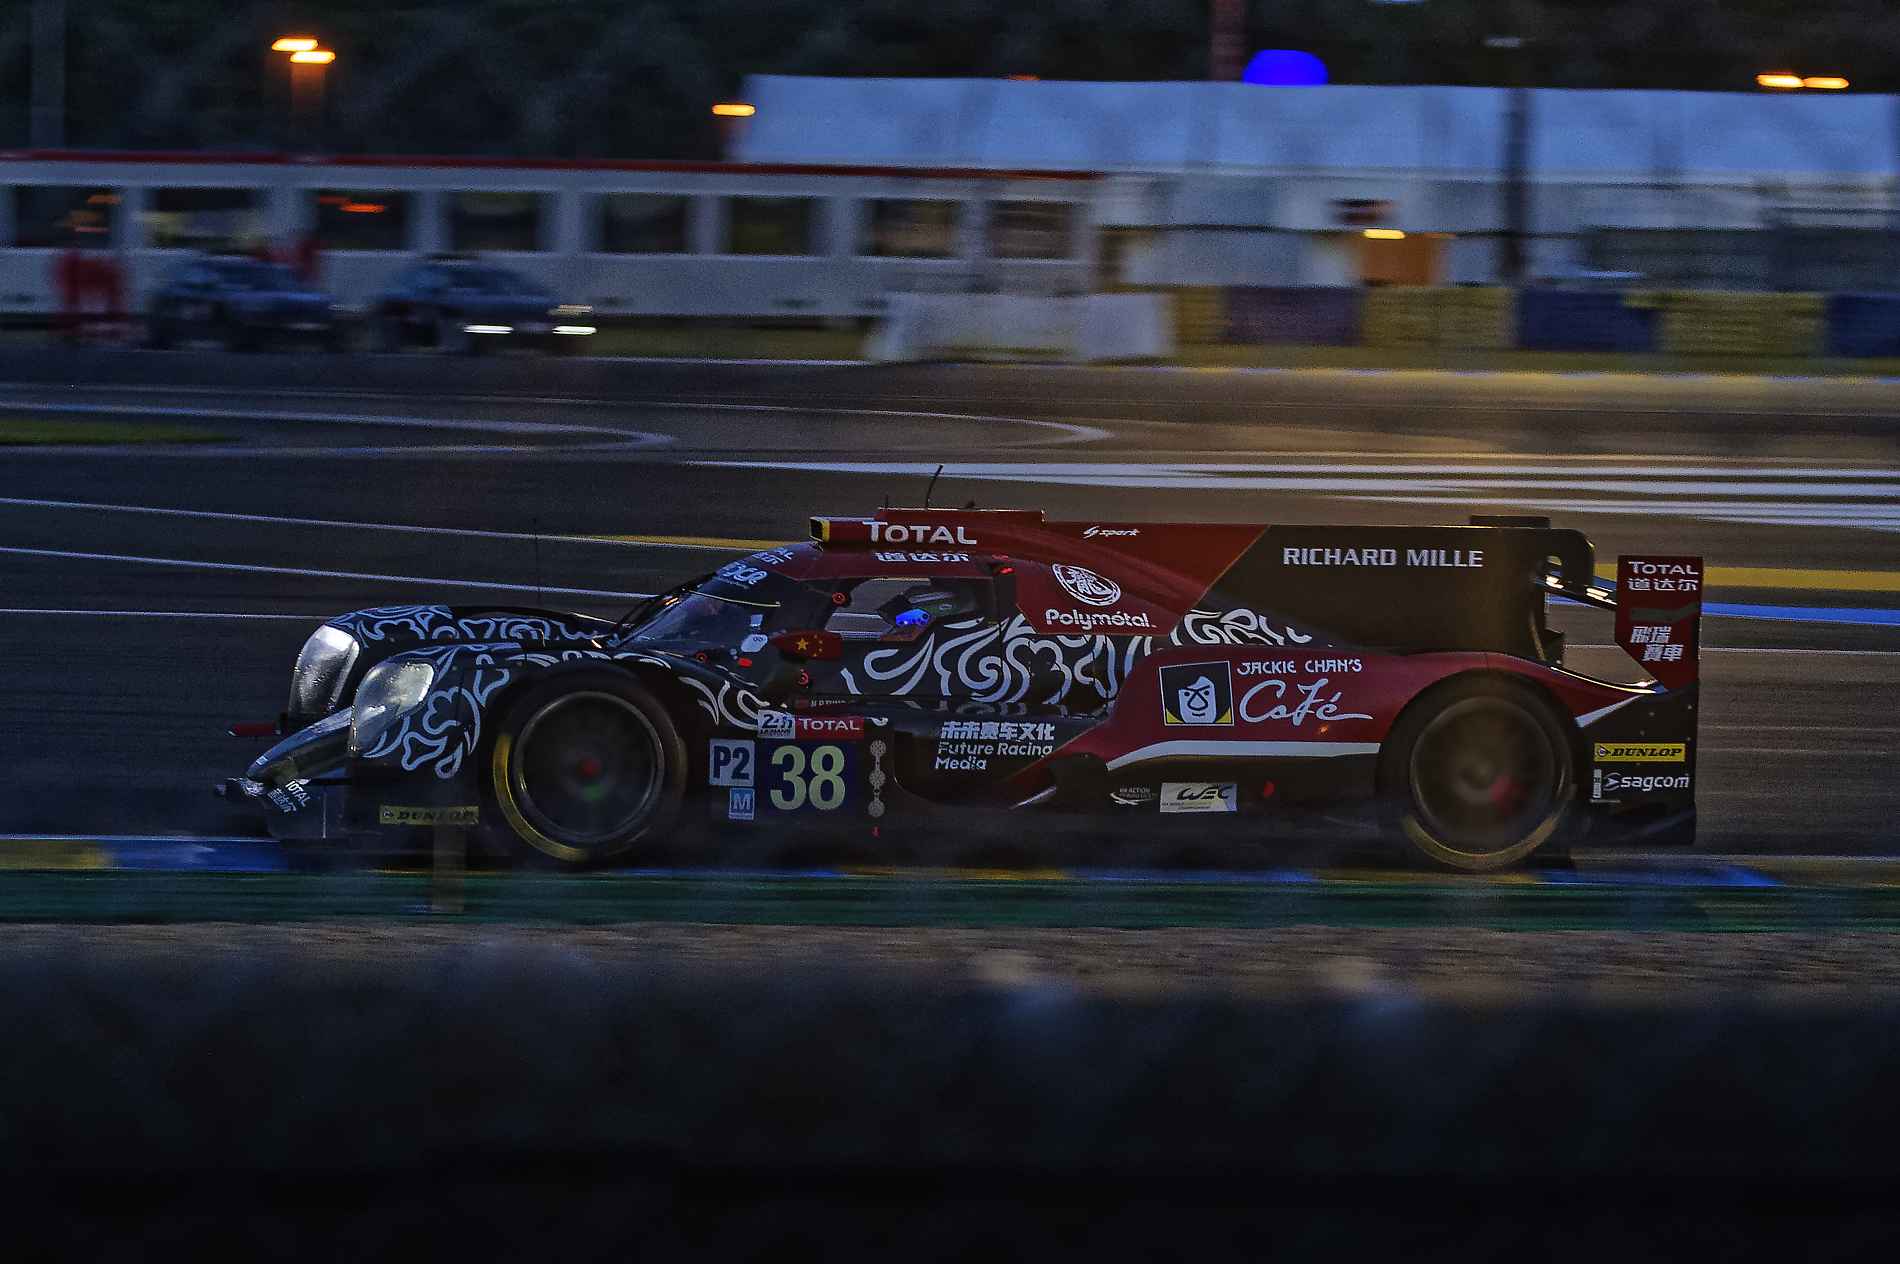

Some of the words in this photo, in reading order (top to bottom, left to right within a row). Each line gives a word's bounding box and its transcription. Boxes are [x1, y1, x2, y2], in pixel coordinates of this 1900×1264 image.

[862, 520, 977, 545] TOTAL
[1283, 547, 1397, 566] RICHARD
[1406, 549, 1484, 568] MILLE
[1628, 561, 1699, 575] TOTAL
[1237, 660, 1297, 676] JACKIE
[1305, 658, 1363, 673] CHAN'S
[798, 717, 861, 731] TOTAL
[938, 741, 994, 756] Future
[997, 742, 1054, 758] Racing
[1611, 748, 1682, 757] DUNLOP
[712, 745, 751, 781] P2
[935, 756, 987, 771] Media
[770, 744, 846, 812] 38
[1620, 776, 1689, 792] sagcom
[285, 780, 311, 808] TOTAL
